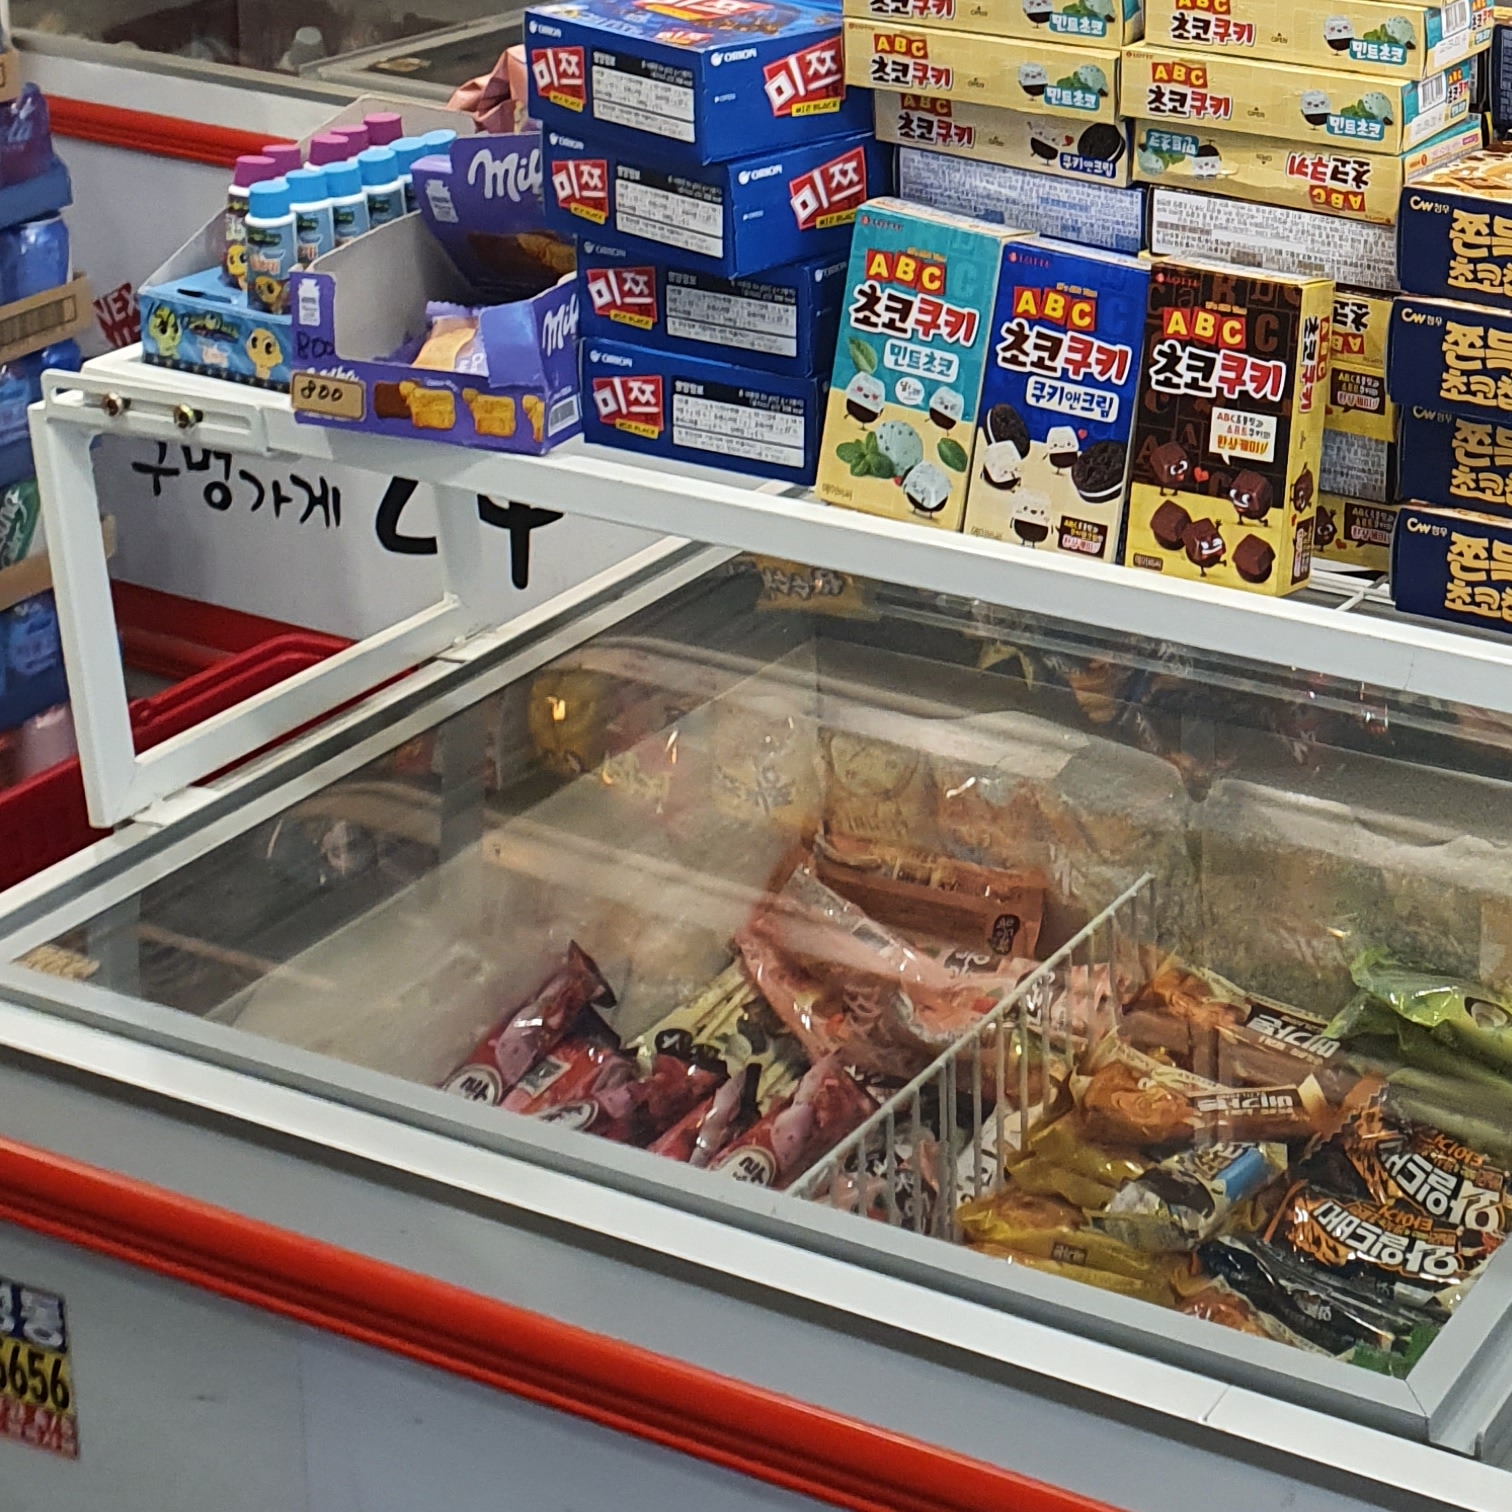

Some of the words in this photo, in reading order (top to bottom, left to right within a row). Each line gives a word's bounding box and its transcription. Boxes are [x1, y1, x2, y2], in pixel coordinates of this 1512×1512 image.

[1052, 13, 1105, 35] 민트초코
[1171, 15, 1256, 46] 초코쿠키
[724, 48, 757, 64] ORION
[874, 35, 927, 57] ABC
[1351, 40, 1405, 62] 민트초코
[533, 47, 581, 91] 미쯔
[764, 42, 843, 102] 미쯔
[869, 58, 953, 89] 초코쿠키
[1151, 63, 1207, 85] ABC
[1045, 86, 1099, 109] 민트초코
[1146, 87, 1231, 118] 초코쿠키
[1327, 115, 1383, 139] 민트초코
[551, 161, 603, 204] 미쯔
[750, 164, 783, 182] ORION
[791, 153, 865, 221] 미쯔
[588, 270, 655, 309] 미쯔
[867, 252, 944, 293] ABC
[848, 285, 980, 347] 초코쿠키
[1015, 288, 1095, 330] ABC
[1164, 308, 1244, 348] ABC
[888, 344, 956, 379] 민트초코
[998, 320, 1131, 383] 초코쿠키
[1151, 341, 1288, 401] 초코쿠키
[300, 385, 344, 403] 800
[594, 377, 662, 417] 미쯔
[1031, 383, 1115, 420] 쿠키앤크림
